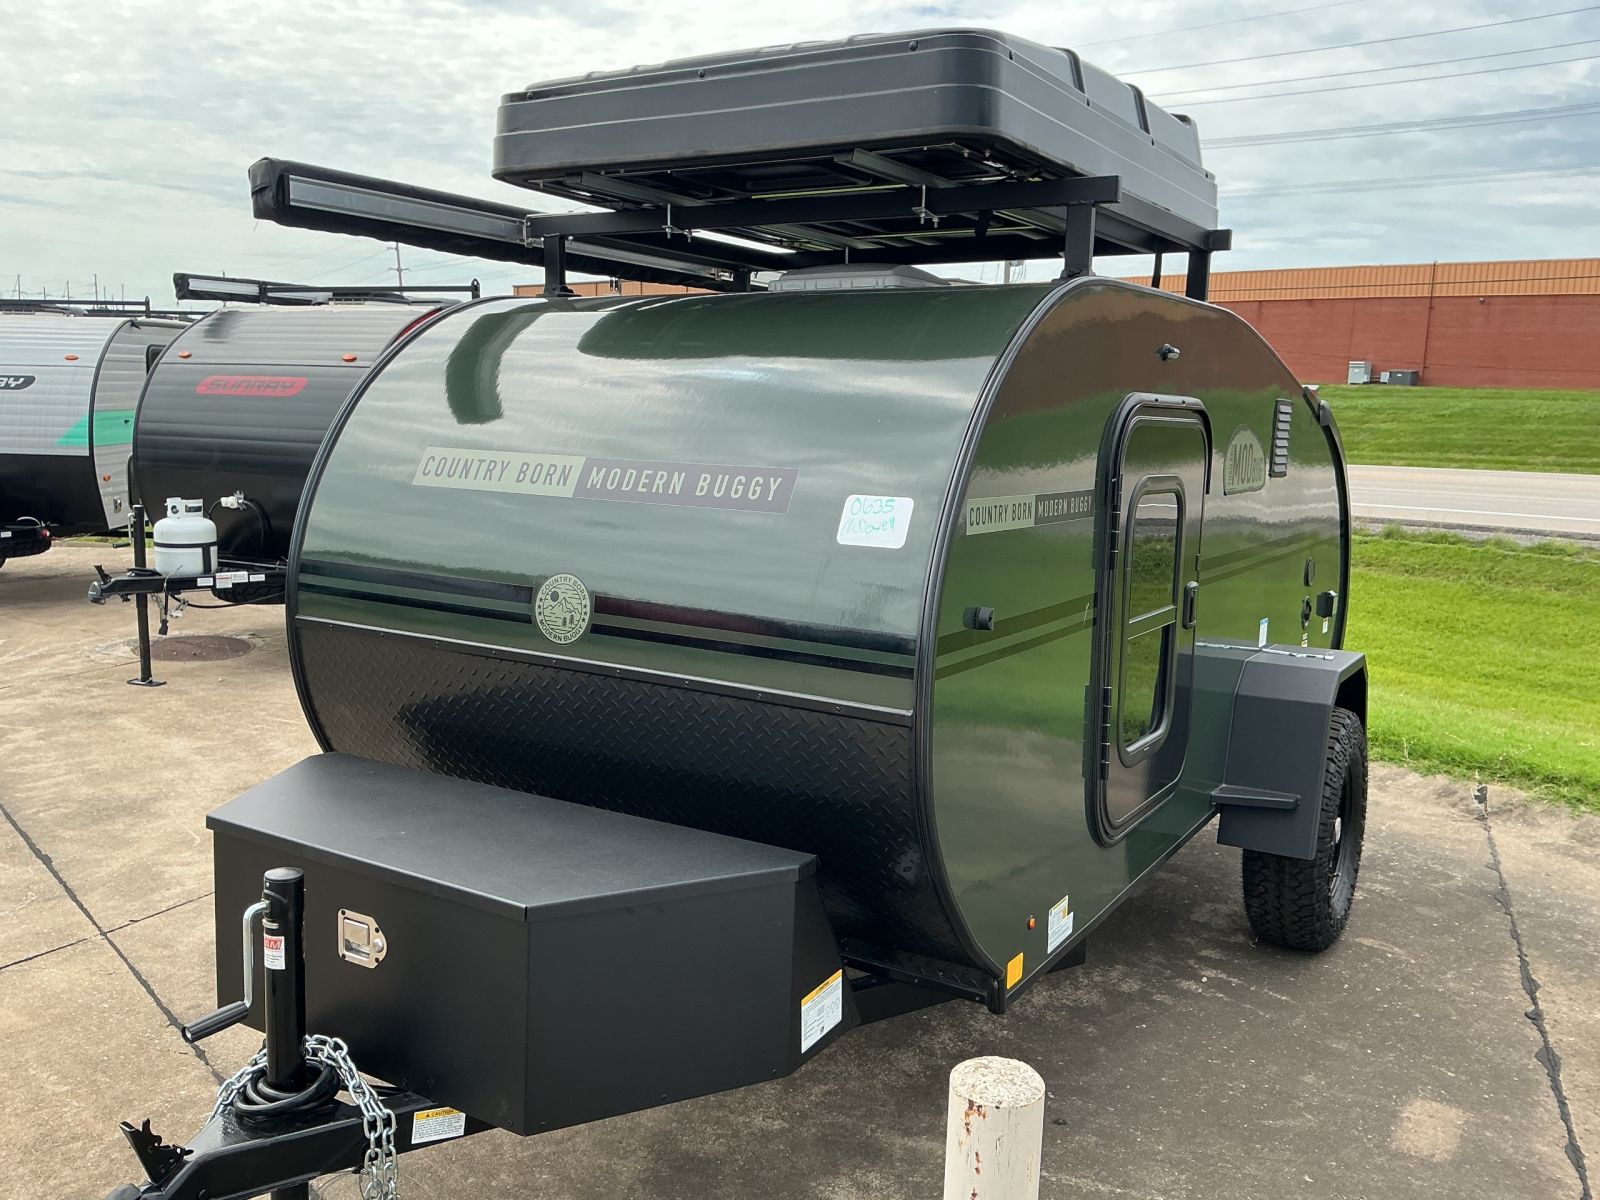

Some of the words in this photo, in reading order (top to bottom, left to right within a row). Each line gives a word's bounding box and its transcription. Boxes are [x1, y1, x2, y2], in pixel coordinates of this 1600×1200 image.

[207, 379, 298, 393] SUNRAY
[421, 455, 511, 482] COUNTRY
[515, 461, 574, 487] BORN
[586, 466, 686, 495] MODERN
[695, 473, 783, 501] BUGGY
[969, 504, 1009, 527] COUNTRY
[1011, 501, 1033, 521] BORN
[1038, 498, 1068, 518] MODERN
[1070, 495, 1093, 514] BUGGY
[541, 576, 573, 595] COUNTRY
[572, 579, 588, 601] BORN
[539, 618, 562, 642] MODERN
[563, 624, 583, 642] BUGGY
